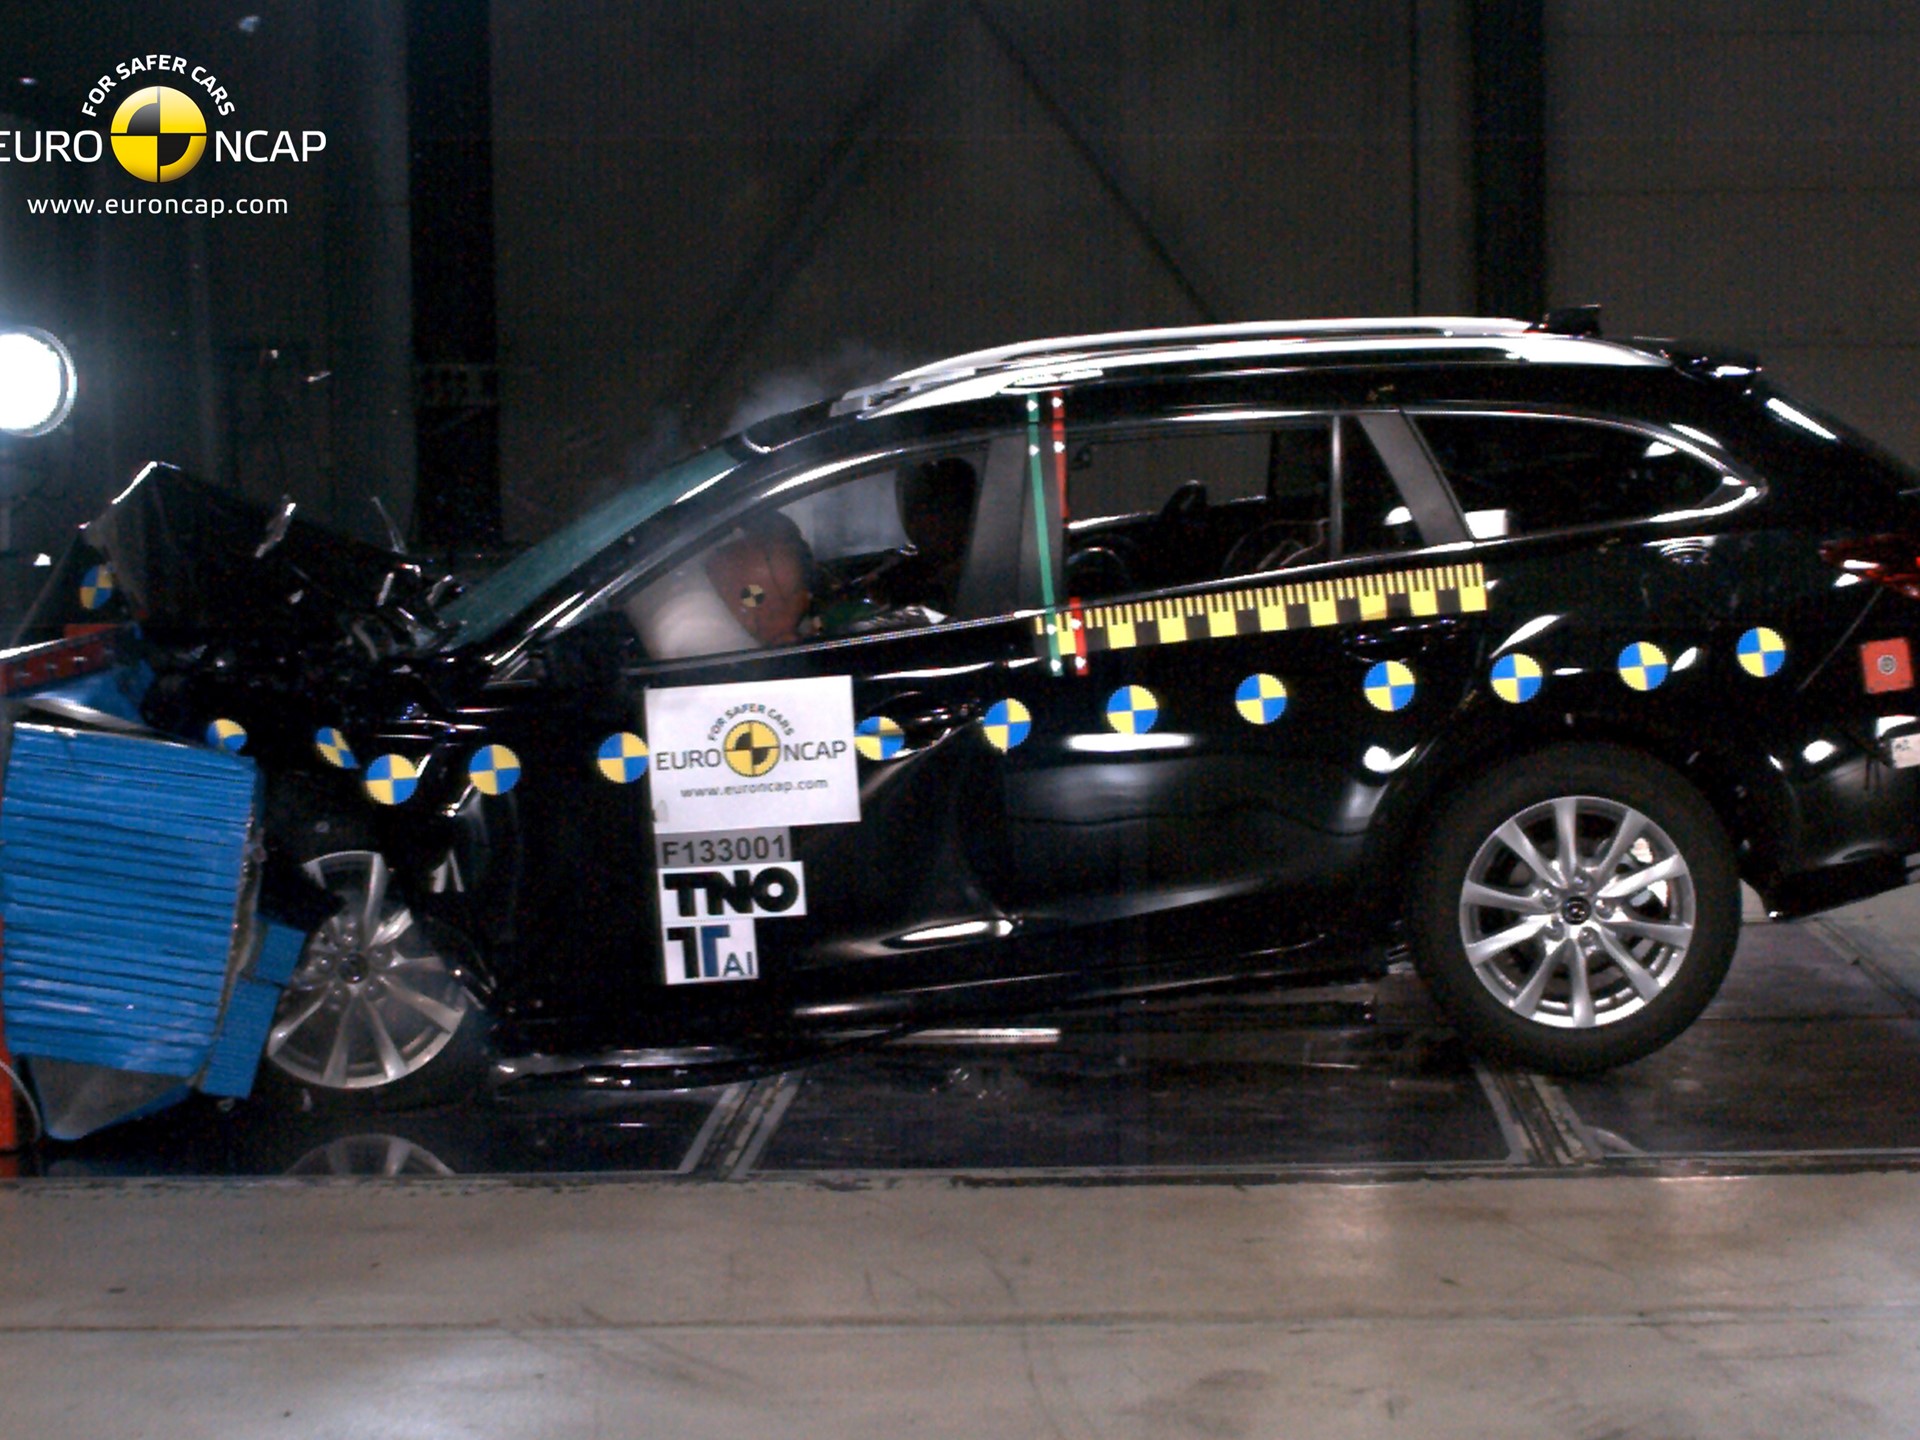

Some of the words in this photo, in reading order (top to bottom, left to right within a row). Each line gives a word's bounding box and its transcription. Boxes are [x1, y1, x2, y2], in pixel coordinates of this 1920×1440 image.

[707, 717, 727, 742] FOR
[725, 703, 766, 720] SAFER
[767, 708, 795, 736] CARS
[656, 749, 722, 771] EURO
[784, 740, 847, 762] NCAP
[680, 778, 829, 798] www.euroncap.com
[662, 834, 785, 865] F133001
[664, 866, 799, 917] TNO
